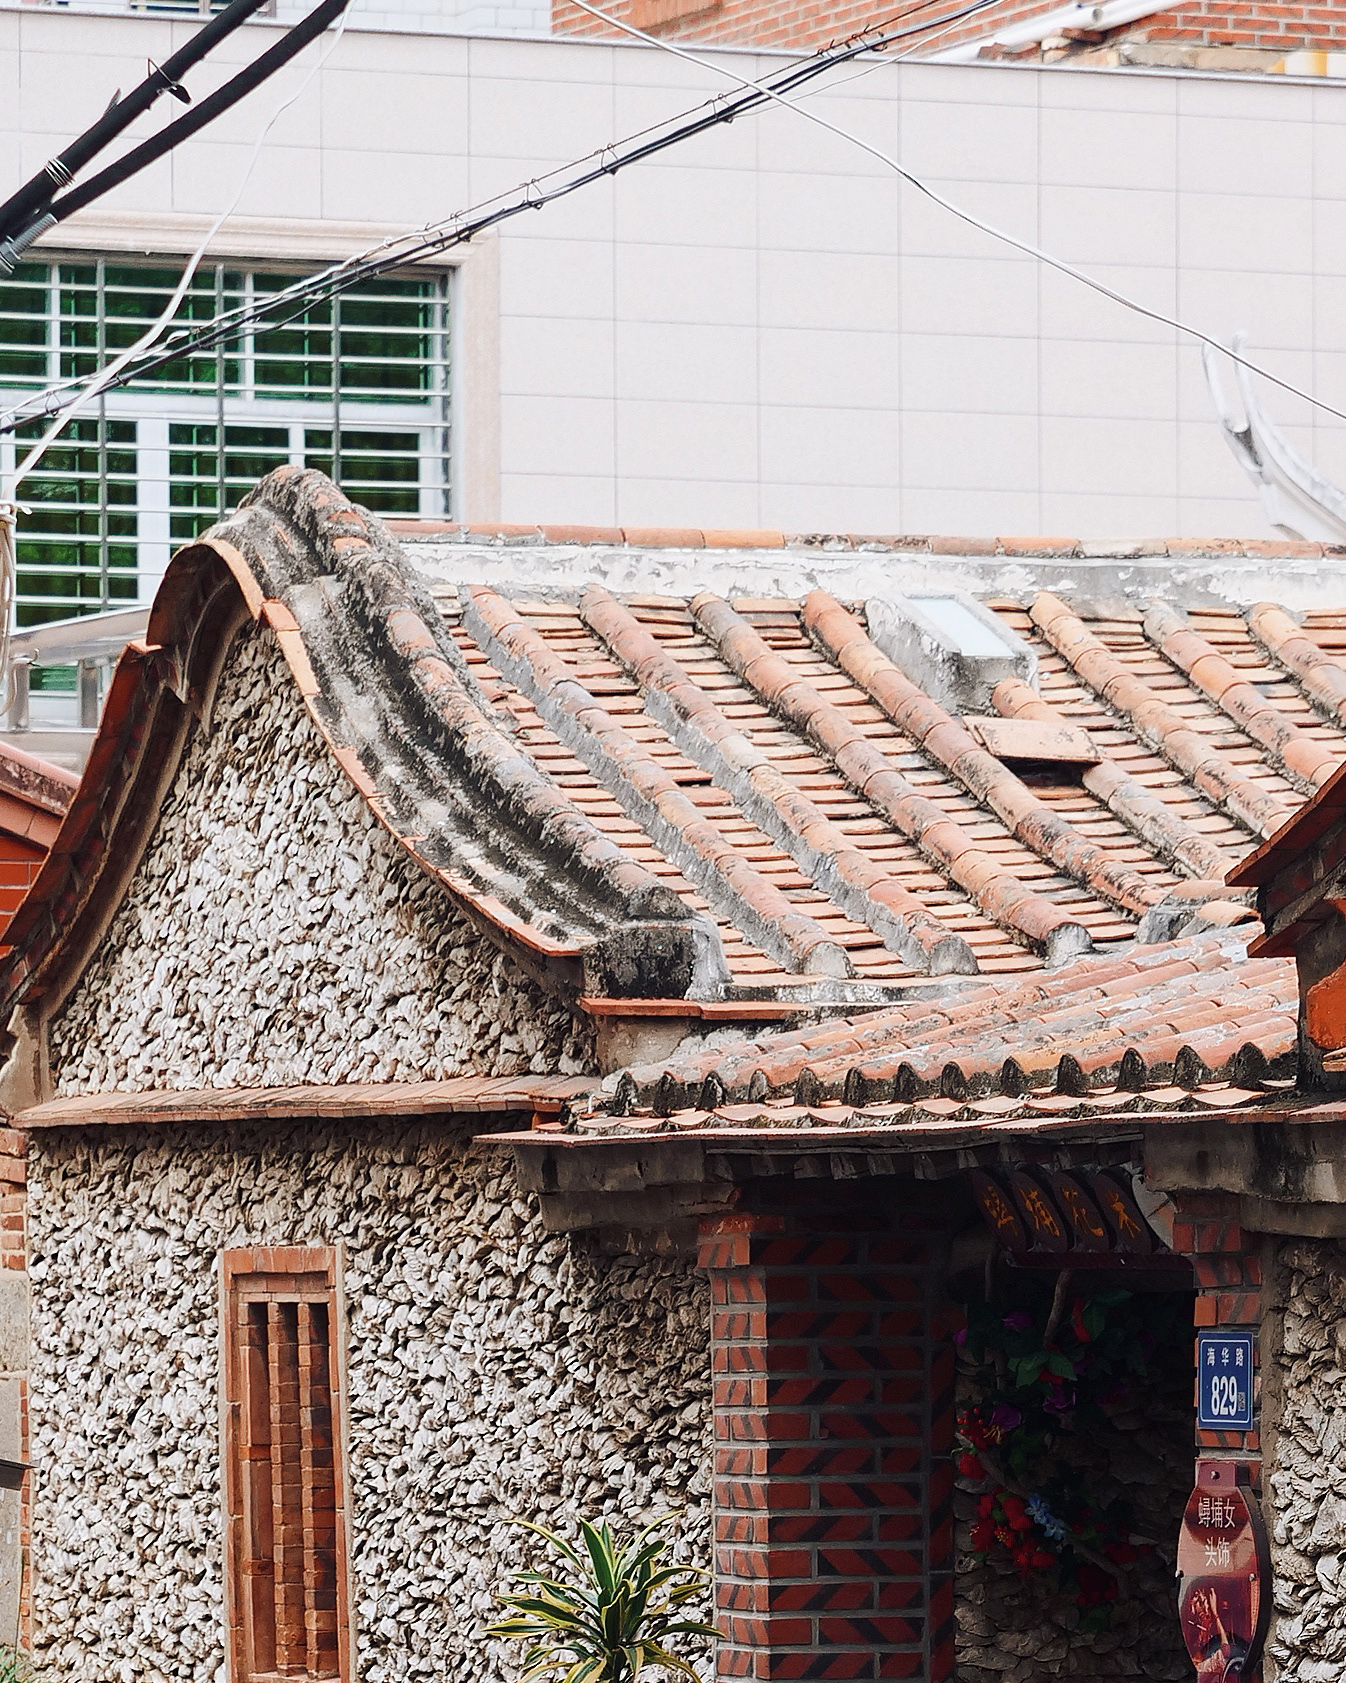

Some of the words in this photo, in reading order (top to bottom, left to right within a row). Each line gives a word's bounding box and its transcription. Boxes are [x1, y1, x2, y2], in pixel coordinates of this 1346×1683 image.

[1211, 1375, 1238, 1416] 829
[1198, 1496, 1236, 1529] 蟳埔女
[1204, 1536, 1231, 1568] 头饰
